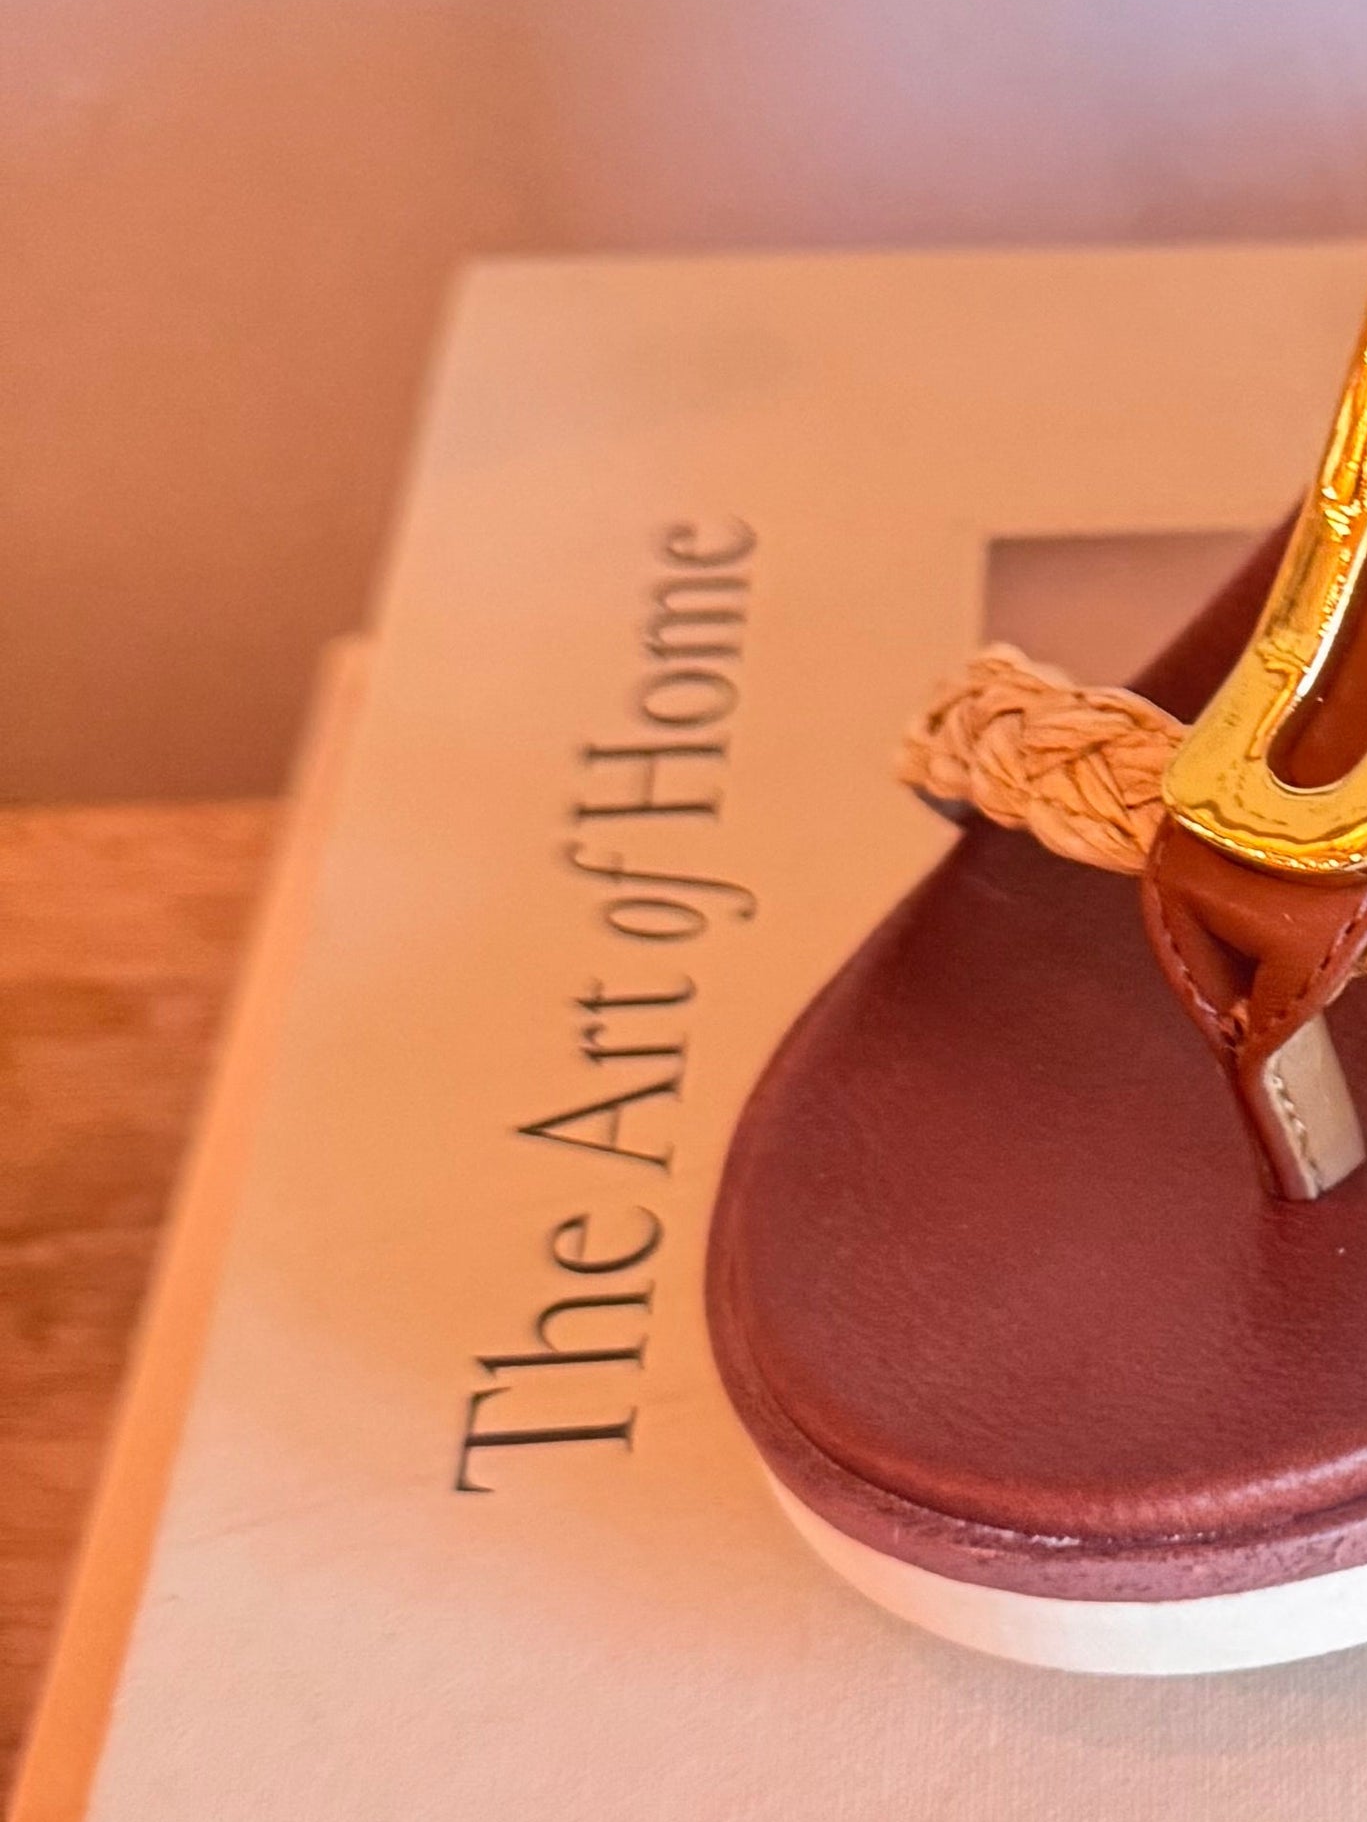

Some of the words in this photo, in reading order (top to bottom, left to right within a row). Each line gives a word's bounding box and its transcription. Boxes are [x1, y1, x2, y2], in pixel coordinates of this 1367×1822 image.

[571, 512, 759, 824] Home
[565, 840, 758, 943] of
[516, 974, 697, 1176] Art
[454, 1203, 664, 1496] The
